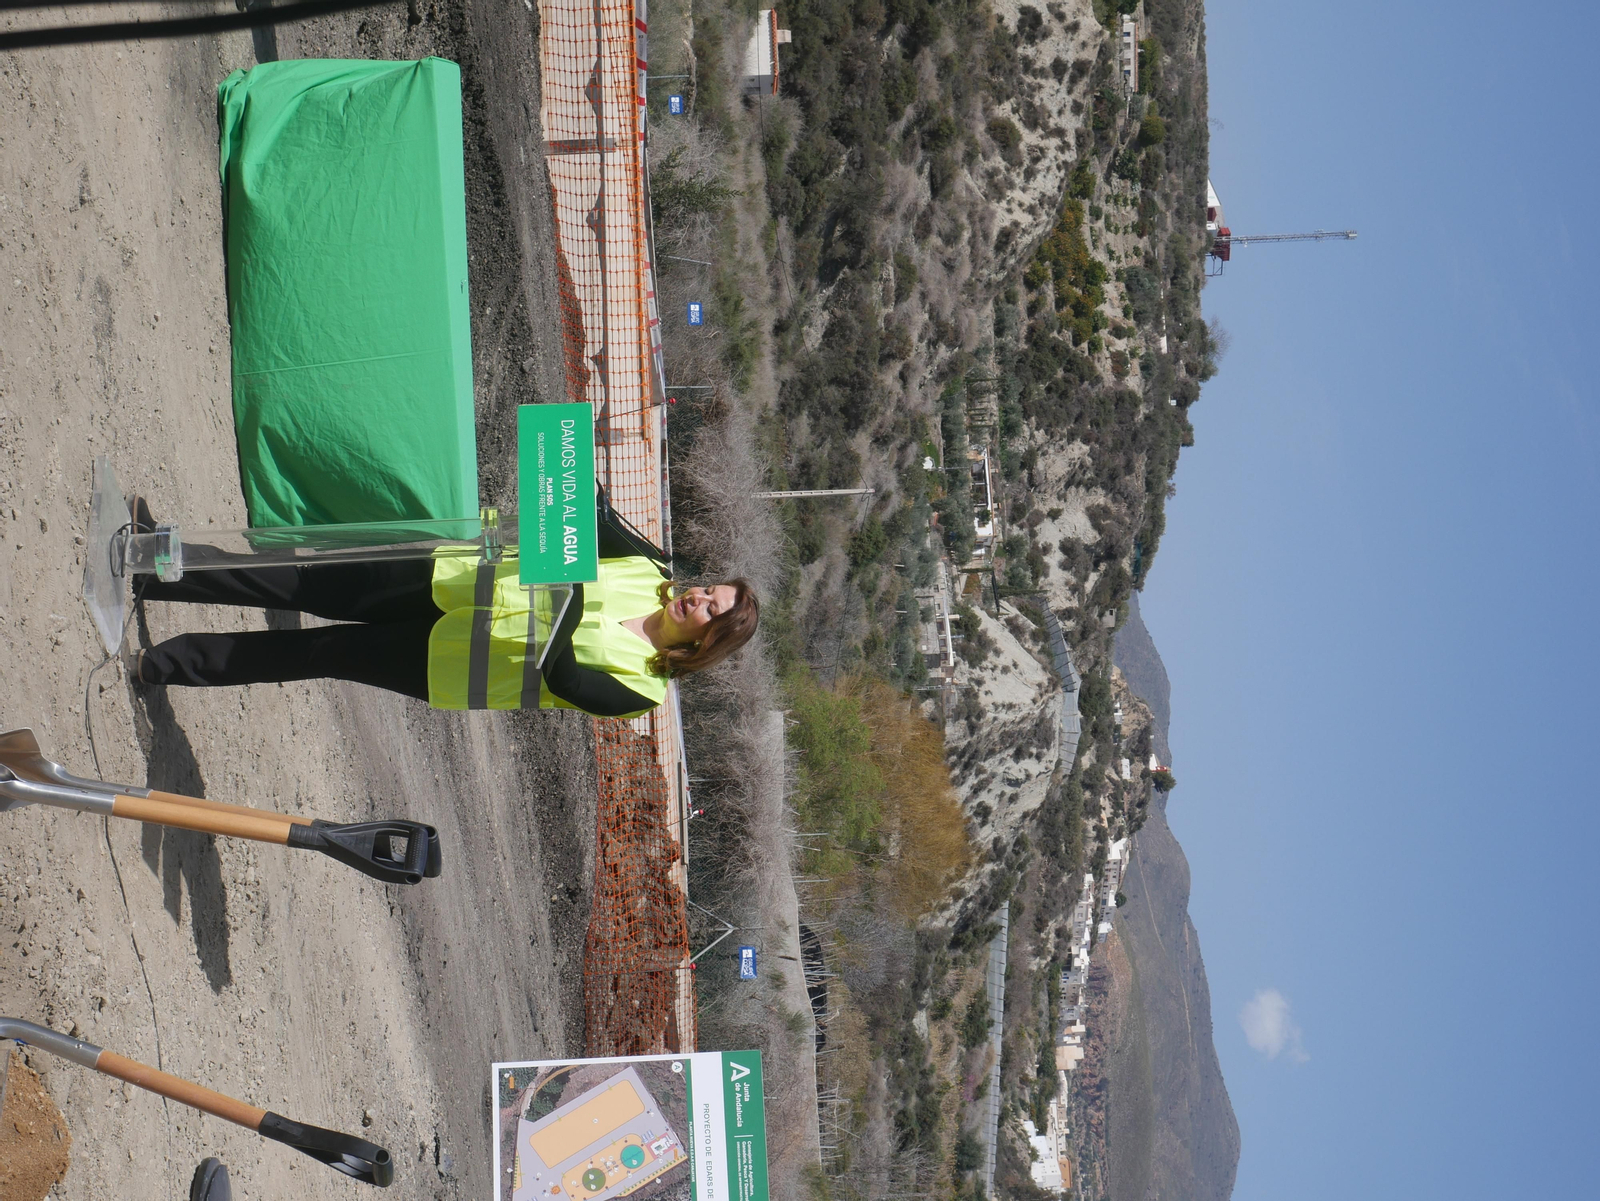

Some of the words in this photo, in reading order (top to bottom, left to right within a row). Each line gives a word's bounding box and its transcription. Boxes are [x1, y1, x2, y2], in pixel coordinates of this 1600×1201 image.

[561, 420, 575, 467] DAMOS
[562, 471, 576, 501] VIDA
[563, 505, 576, 522] AL
[539, 532, 547, 553] SEQUÍA
[564, 526, 577, 564] AGUA
[735, 1083, 741, 1091] de
[735, 1093, 743, 1127] Andalucía
[703, 1104, 711, 1144] PROYECTO
[706, 1147, 712, 1156] DE
[707, 1189, 714, 1199] DE
